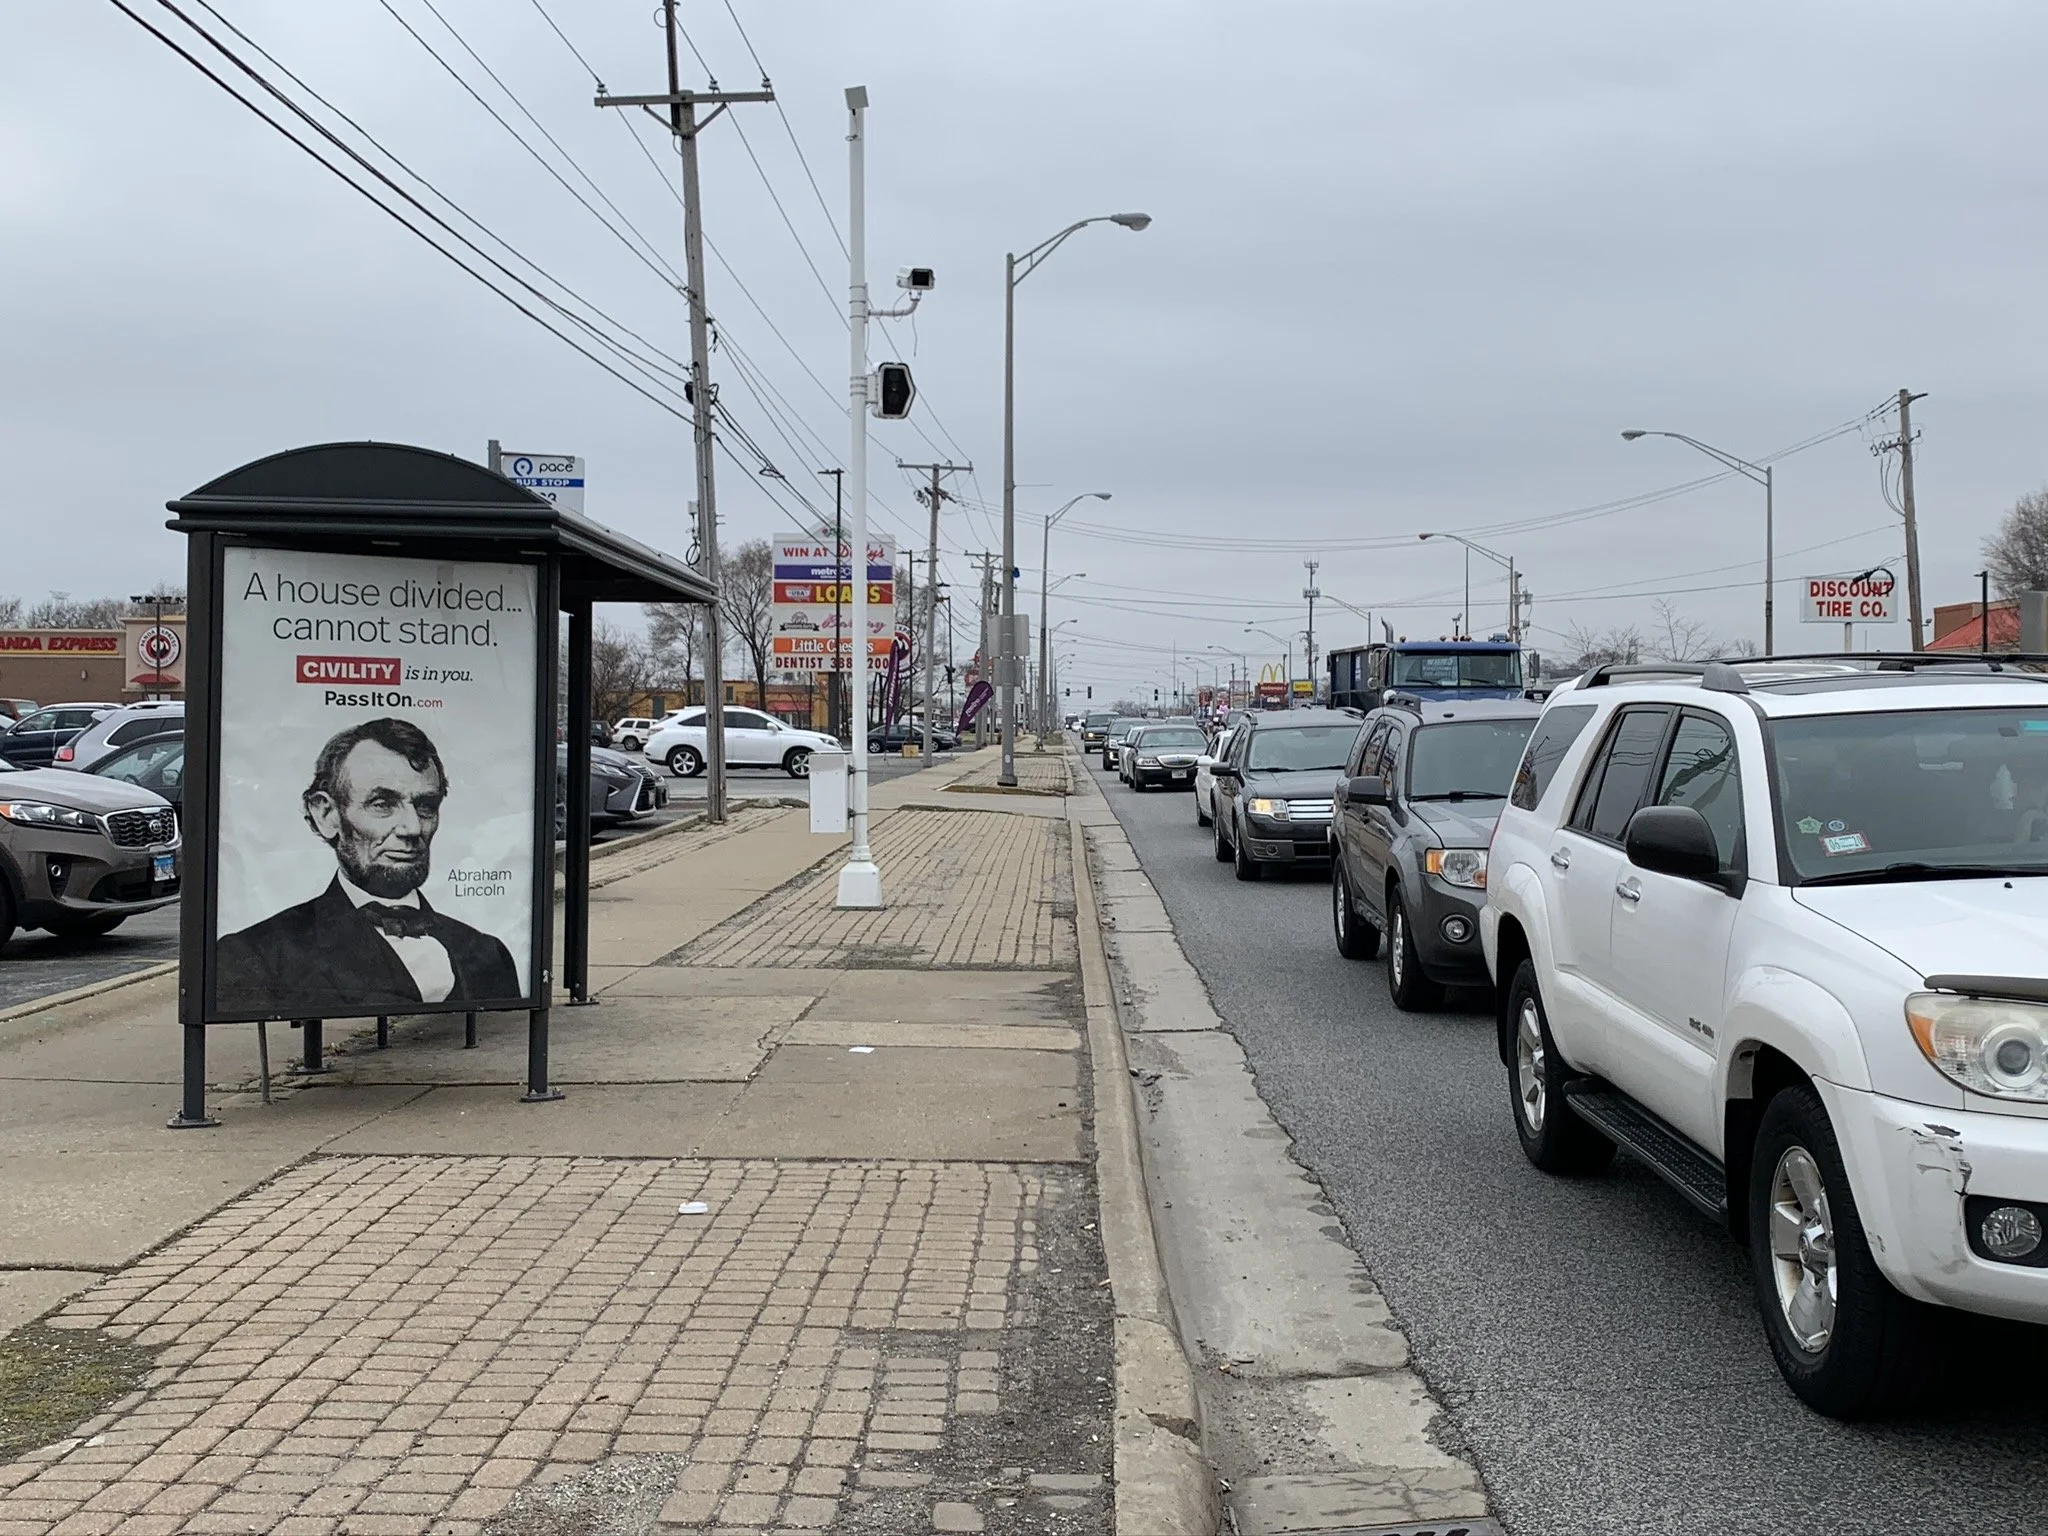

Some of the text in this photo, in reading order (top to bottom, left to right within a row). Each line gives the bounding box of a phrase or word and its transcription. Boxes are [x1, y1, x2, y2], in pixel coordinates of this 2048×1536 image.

[539, 462, 574, 473] pace
[783, 547, 809, 557] WIN
[813, 547, 828, 557] AT
[811, 566, 852, 576] metroPC
[243, 571, 523, 613] A house divided...
[815, 585, 881, 602] LOAS
[1810, 581, 1892, 597] DISCOUNT
[1816, 601, 1887, 617] TIRE CO.
[273, 616, 498, 648] cannot stand.
[48, 636, 118, 651] EXPRESS
[791, 638, 824, 653] Little
[775, 657, 823, 669] DENTIST
[303, 661, 473, 684] CIVILITY is in you.
[448, 868, 512, 882] Abraham
[455, 883, 505, 897] Lincoln
